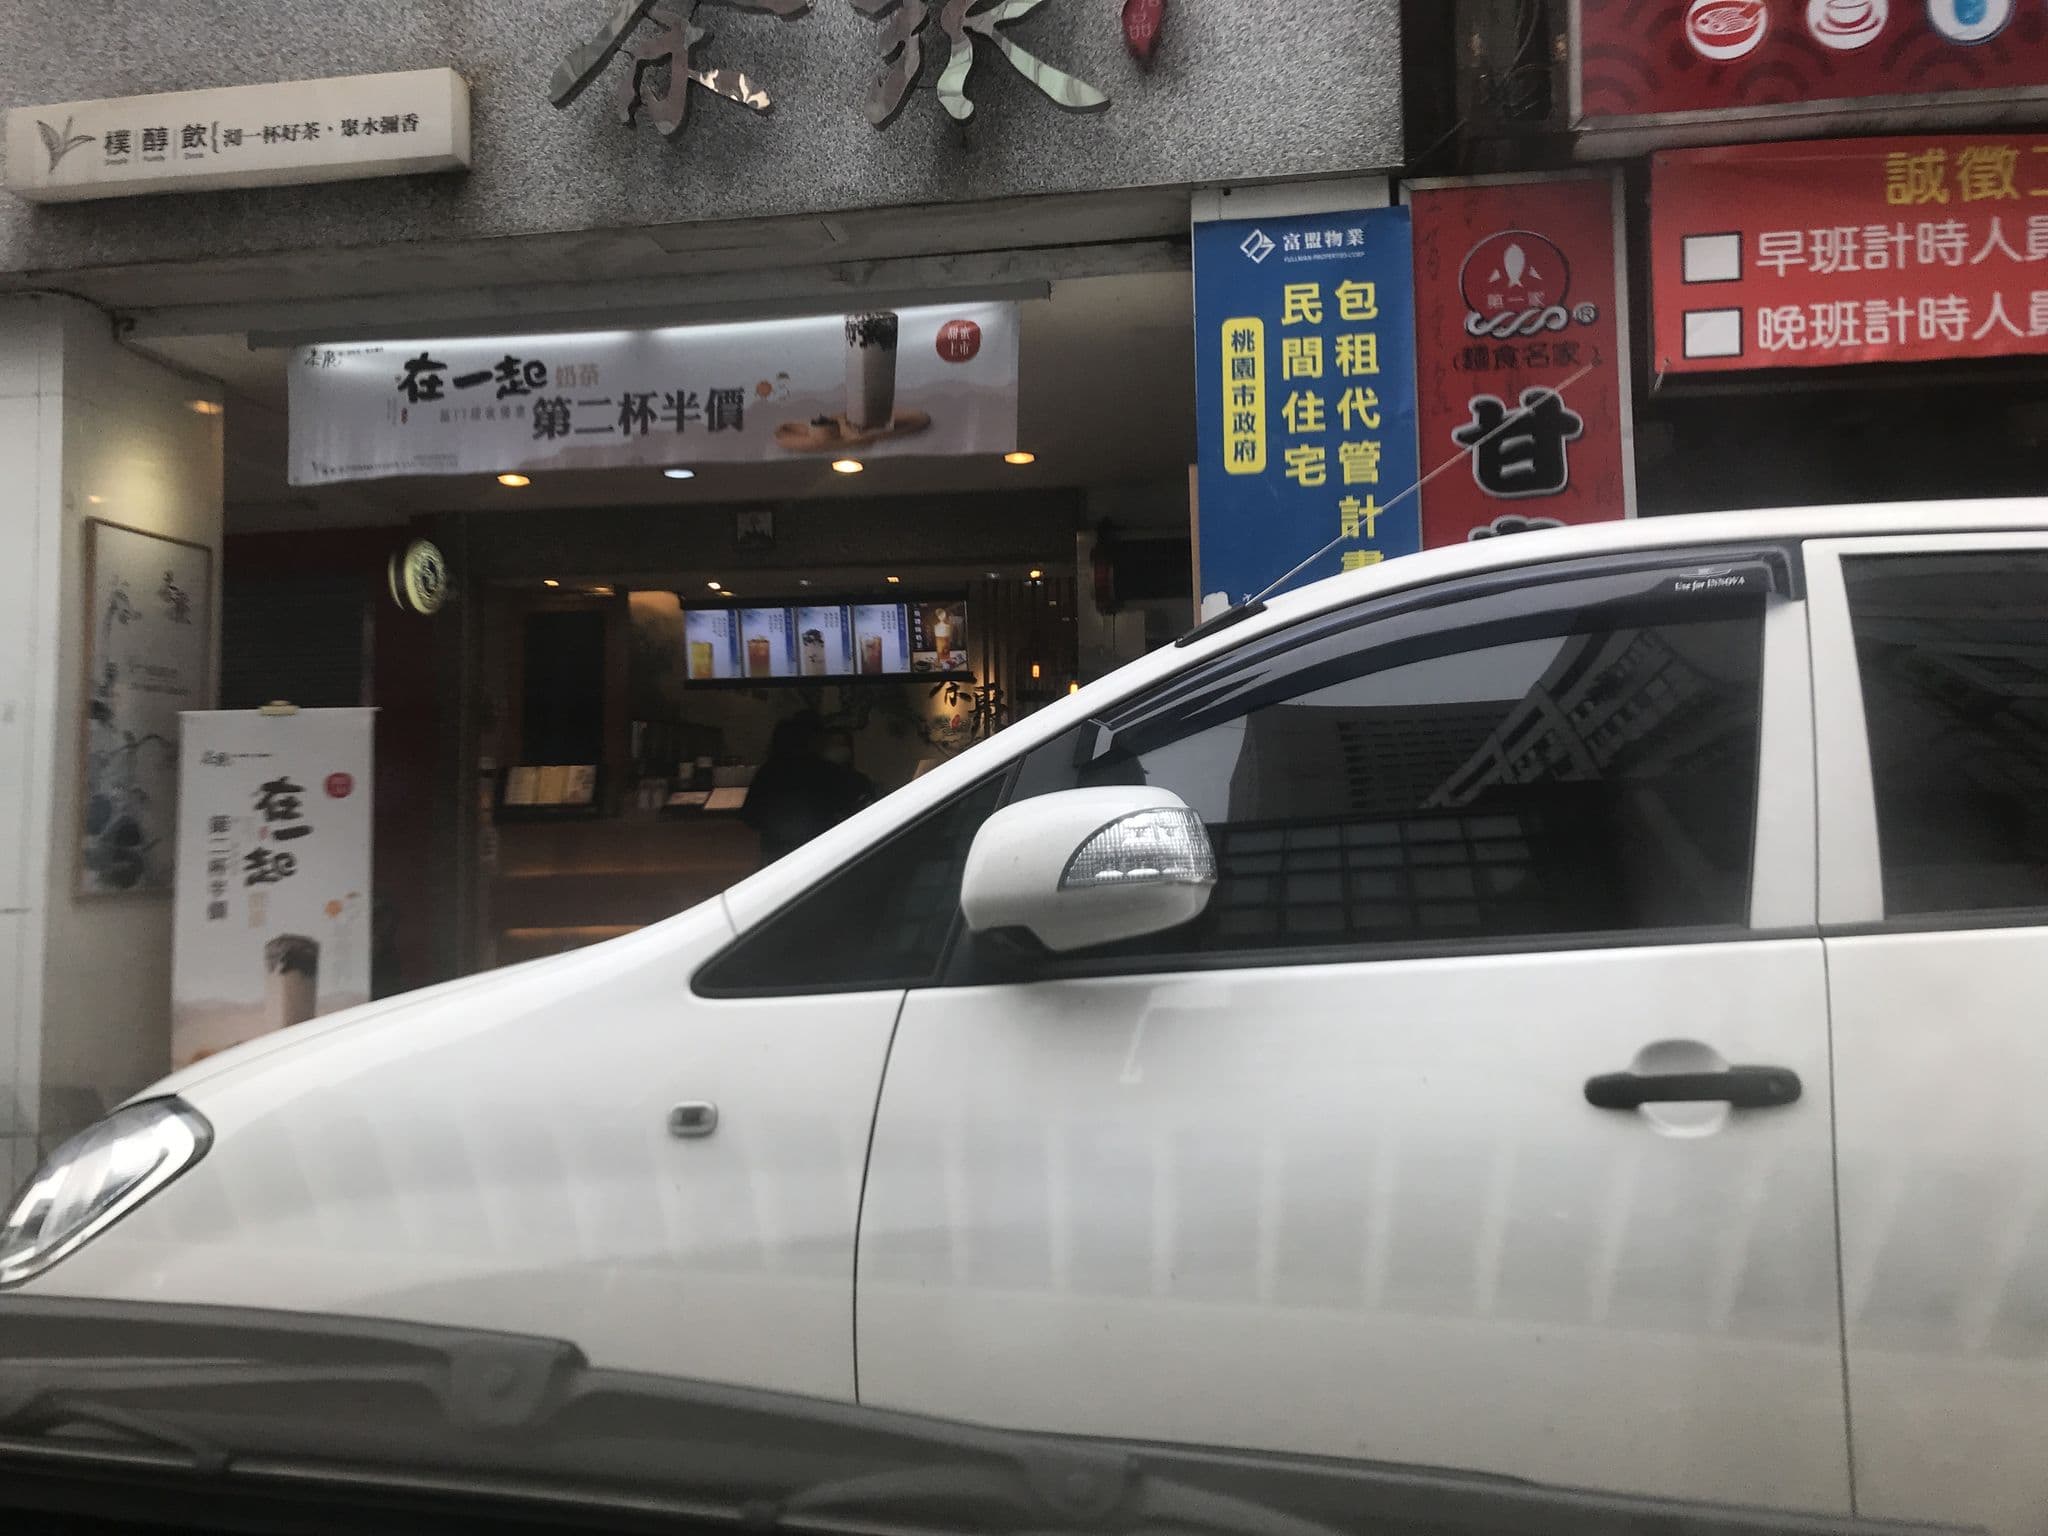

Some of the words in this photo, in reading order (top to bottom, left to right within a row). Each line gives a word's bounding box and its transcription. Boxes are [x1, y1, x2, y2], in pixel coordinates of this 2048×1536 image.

[1282, 229, 1365, 252] 富盟物業
[532, 386, 745, 441] 第二杯半價
[1230, 328, 1258, 463] 桃園市政府
[1281, 282, 1327, 488] 民間住宅
[1452, 386, 1584, 540] 甘
